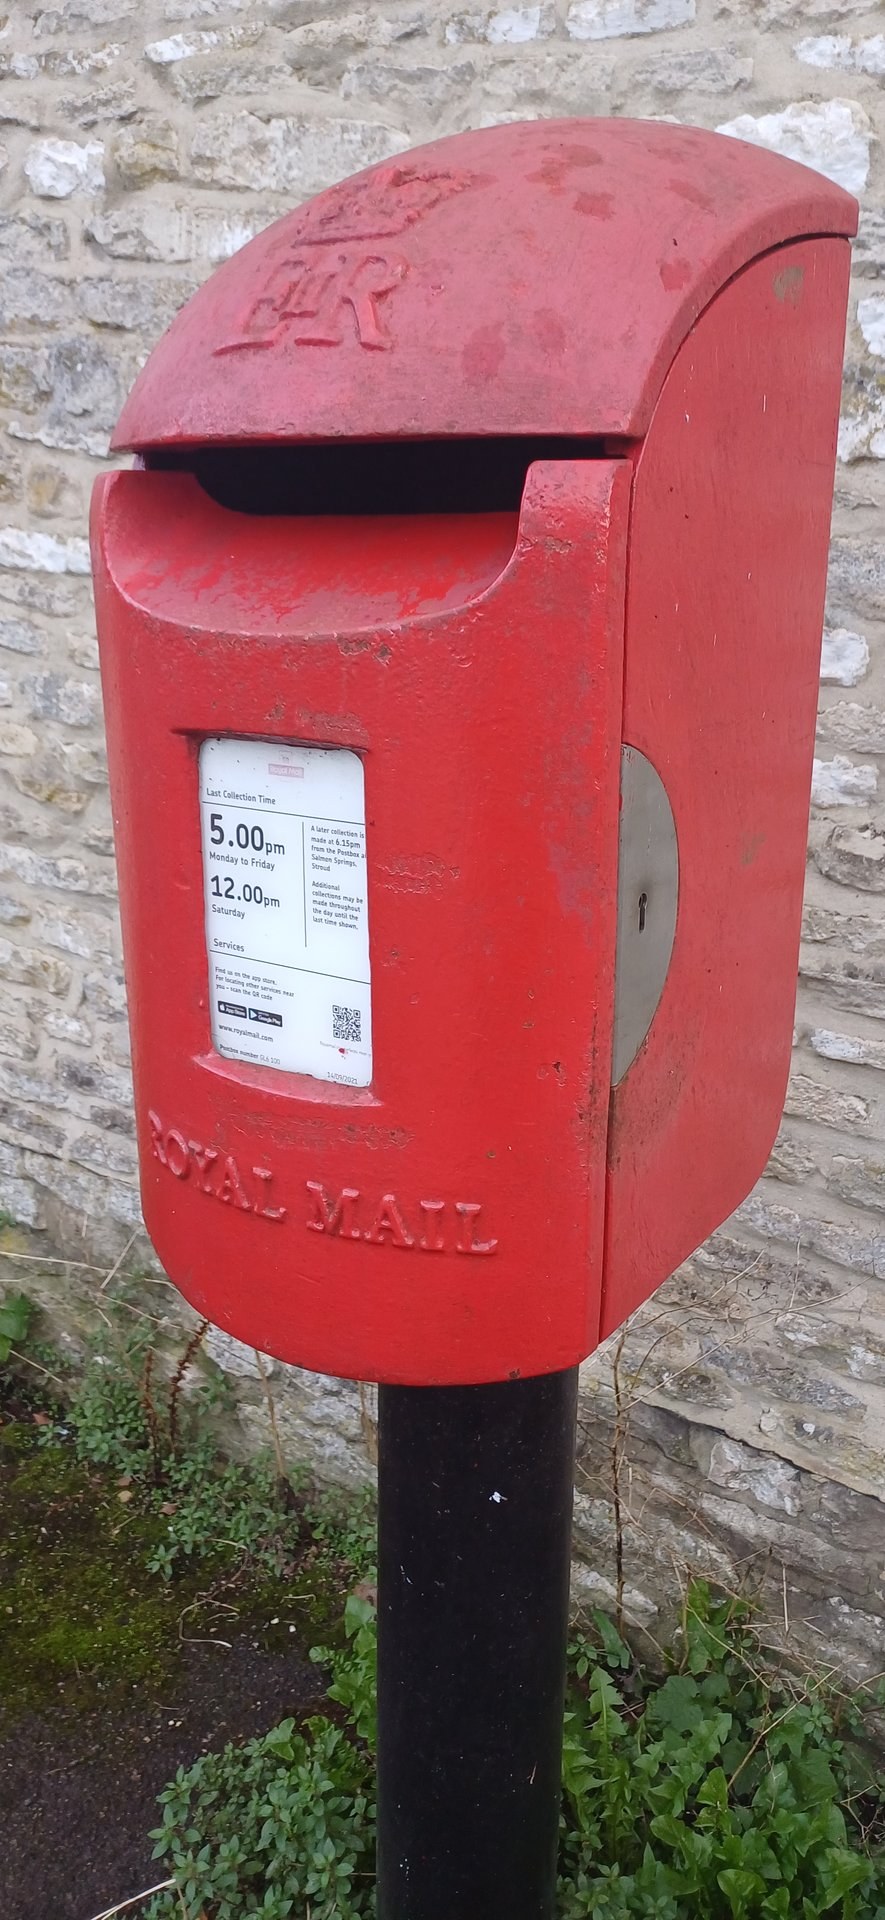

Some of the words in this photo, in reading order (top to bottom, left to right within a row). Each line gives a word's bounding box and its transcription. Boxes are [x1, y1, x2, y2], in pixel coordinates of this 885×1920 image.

[206, 787, 221, 798] Last
[223, 789, 257, 803] Collection
[258, 794, 276, 805] Time
[210, 813, 285, 856] 5.00pm
[316, 826, 330, 834] later
[331, 829, 358, 838] collection
[335, 838, 361, 849] 6.15pm
[311, 853, 333, 863] Salmon
[337, 848, 360, 858] Postbox
[209, 851, 239, 866] Monday
[240, 857, 249, 866] to
[251, 857, 276, 872] Friday
[311, 862, 331, 872] Stroud
[210, 875, 280, 908] 12.00pm
[312, 880, 340, 891] Additional
[312, 890, 342, 900] collections
[343, 895, 355, 904] may
[312, 899, 328, 907] made
[329, 901, 361, 912] throughout
[211, 904, 246, 920] Saturday
[323, 909, 333, 917] day
[324, 918, 337, 926] time
[213, 938, 245, 952] Services
[242, 972, 250, 980] the
[246, 981, 260, 989] other
[218, 1024, 274, 1043] www.royalmail.com
[148, 1109, 288, 1222] ROYAL
[305, 1179, 498, 1255] MAIL
